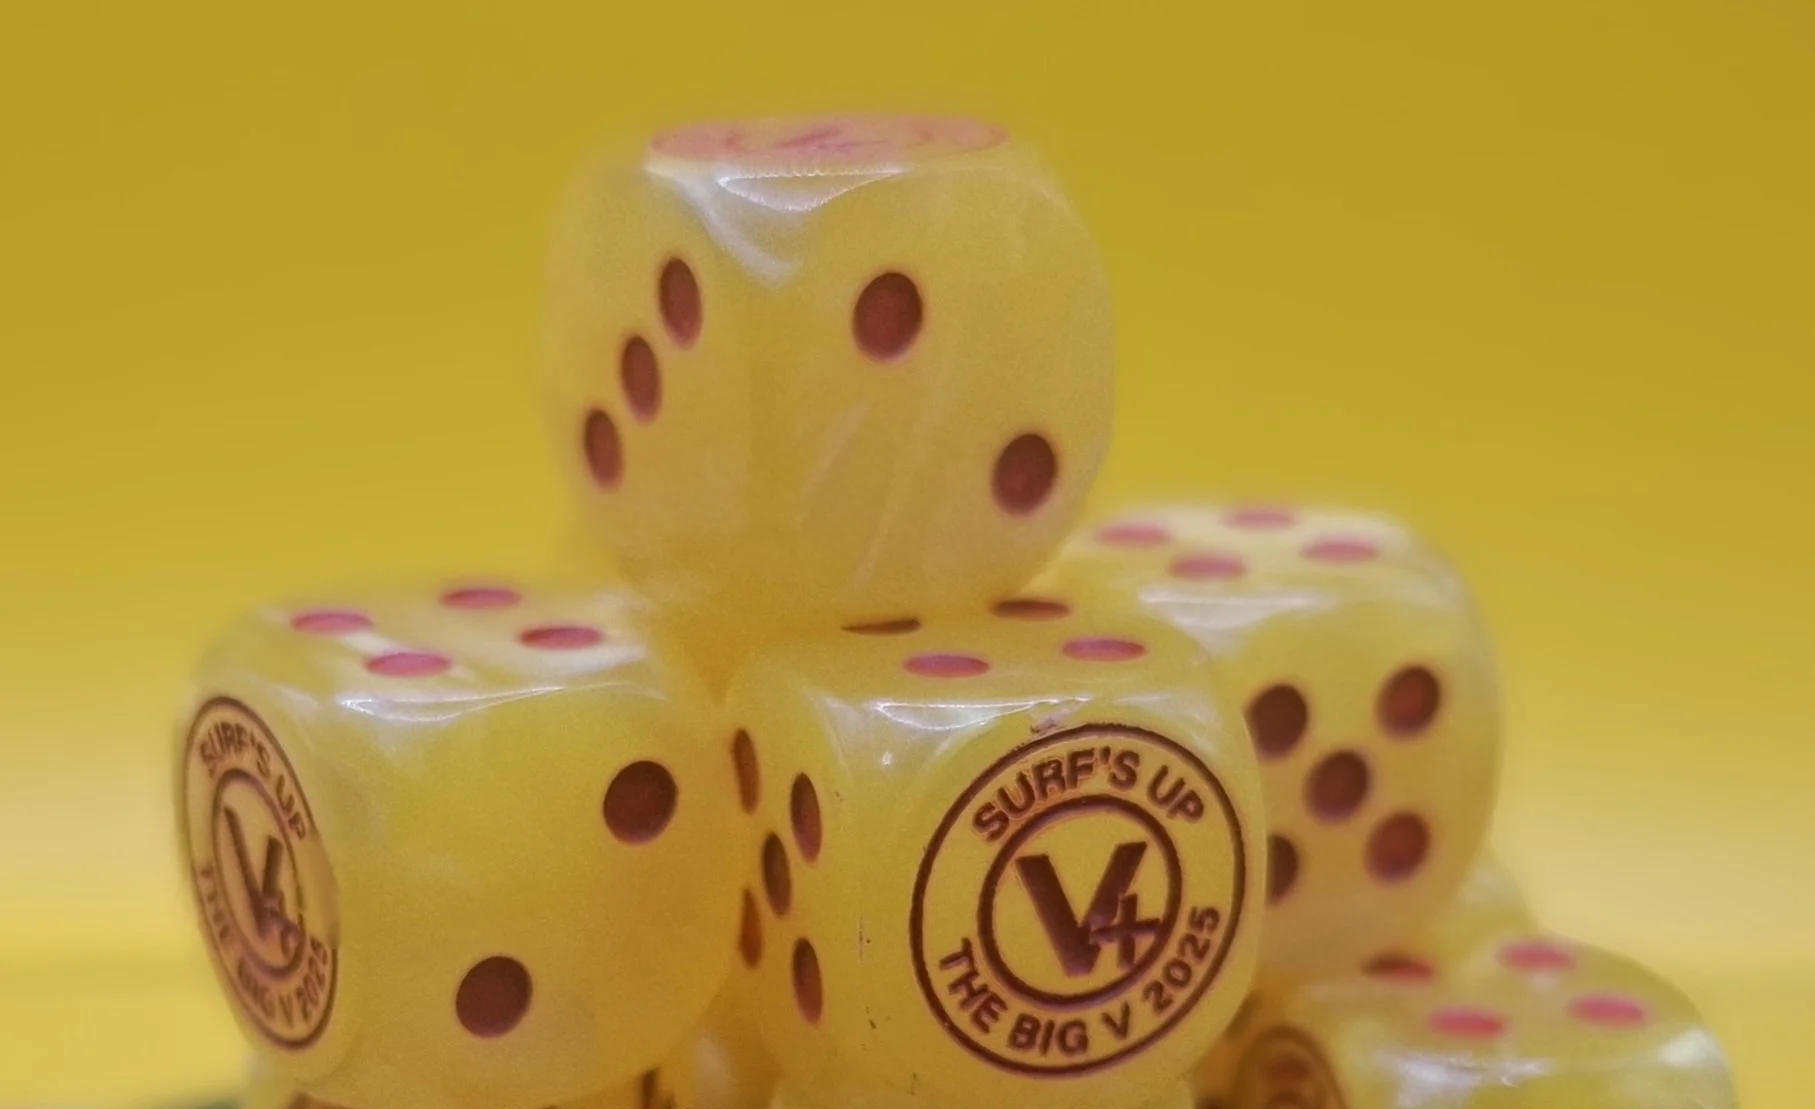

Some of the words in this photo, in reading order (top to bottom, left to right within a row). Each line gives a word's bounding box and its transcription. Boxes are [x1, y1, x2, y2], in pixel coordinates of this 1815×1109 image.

[275, 773, 306, 841] UP
[973, 746, 1140, 842] SURF'S
[1148, 764, 1204, 823] UP
[938, 937, 1009, 1034] THE
[1007, 1012, 1090, 1057] BIG
[1102, 1001, 1131, 1041] V
[1143, 905, 1221, 1016] 2025
